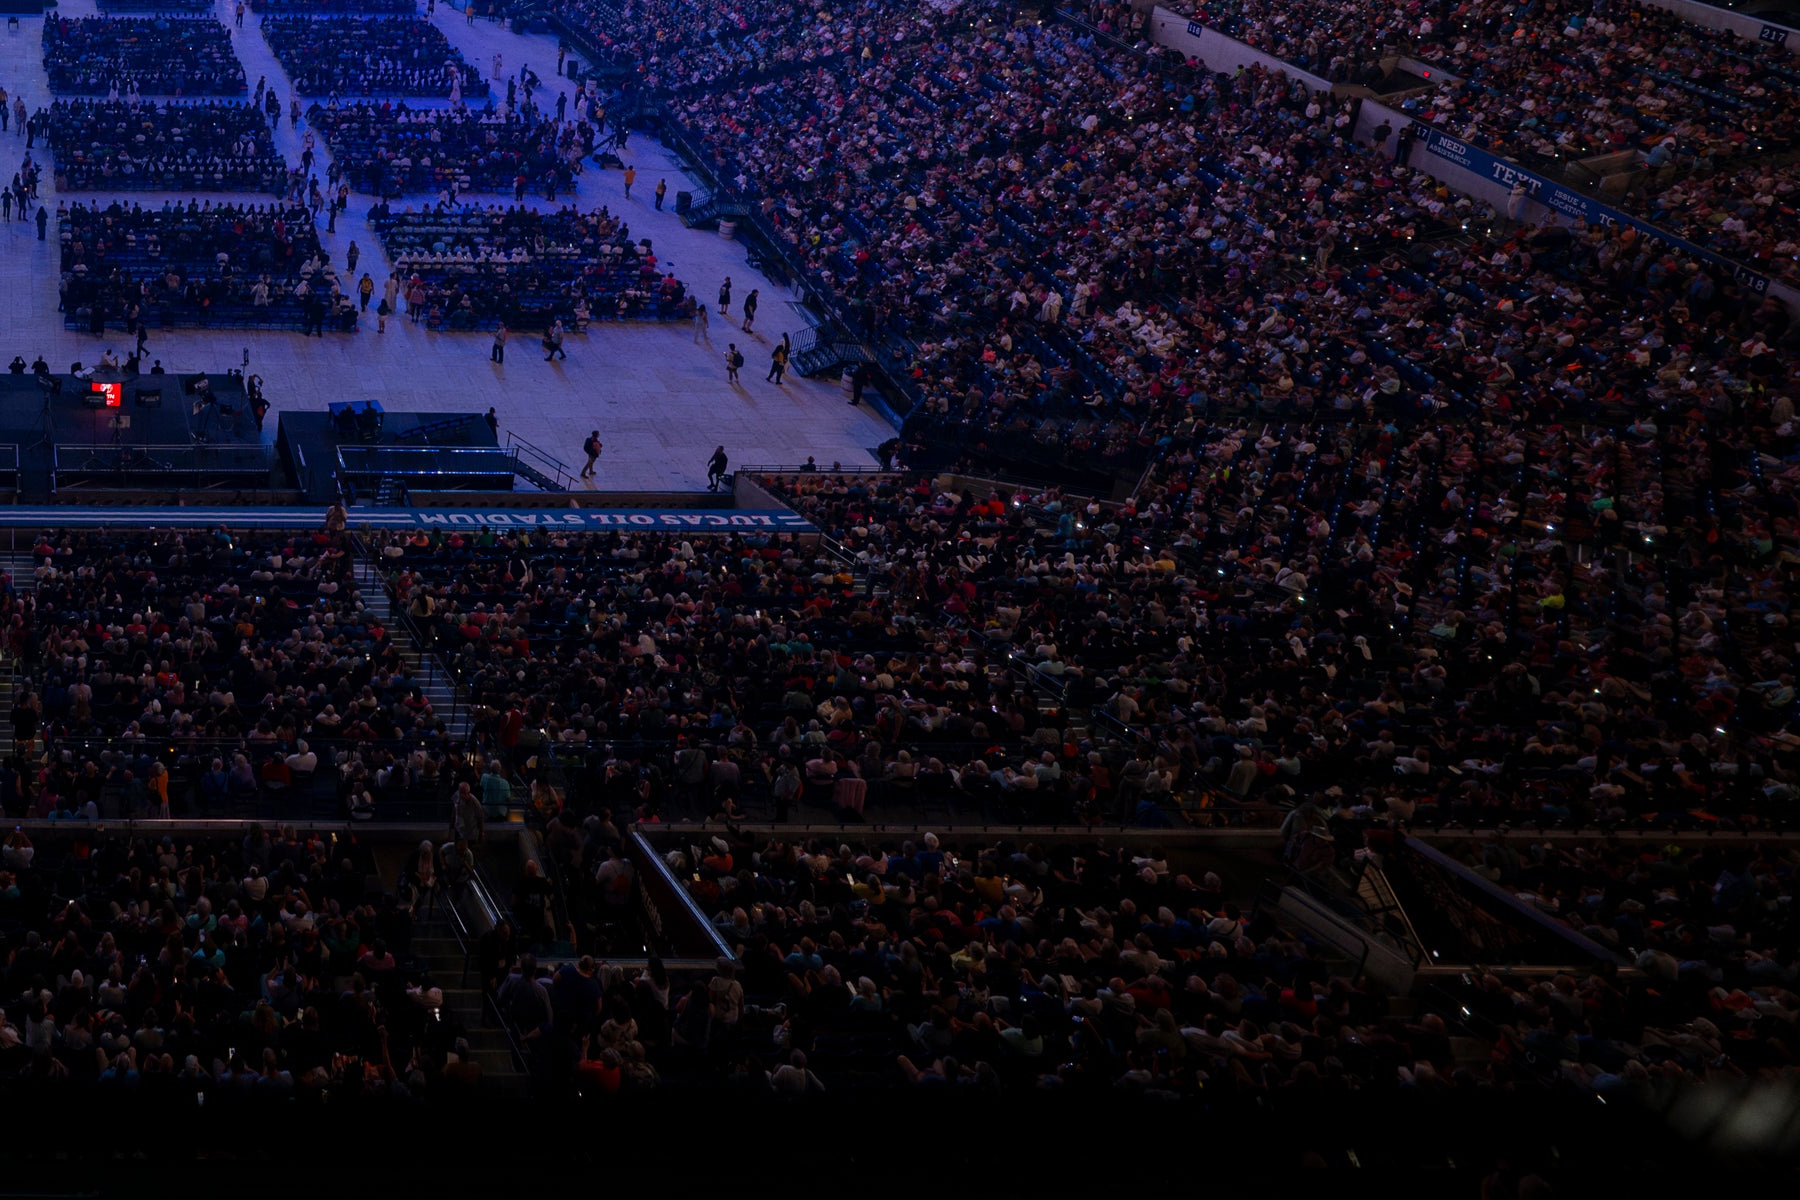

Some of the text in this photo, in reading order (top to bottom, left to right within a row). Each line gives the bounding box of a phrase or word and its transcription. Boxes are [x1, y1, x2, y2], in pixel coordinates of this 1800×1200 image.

[1189, 24, 1201, 36] 116
[1762, 29, 1786, 42] 217
[1429, 143, 1472, 167] ASSISTANCE?
[1438, 136, 1466, 155] NEED
[1492, 161, 1542, 195] TEXT
[1554, 189, 1587, 209] ISSUE &
[1741, 272, 1765, 291] 118
[418, 512, 776, 525] LUCAS OIL STADIUM
